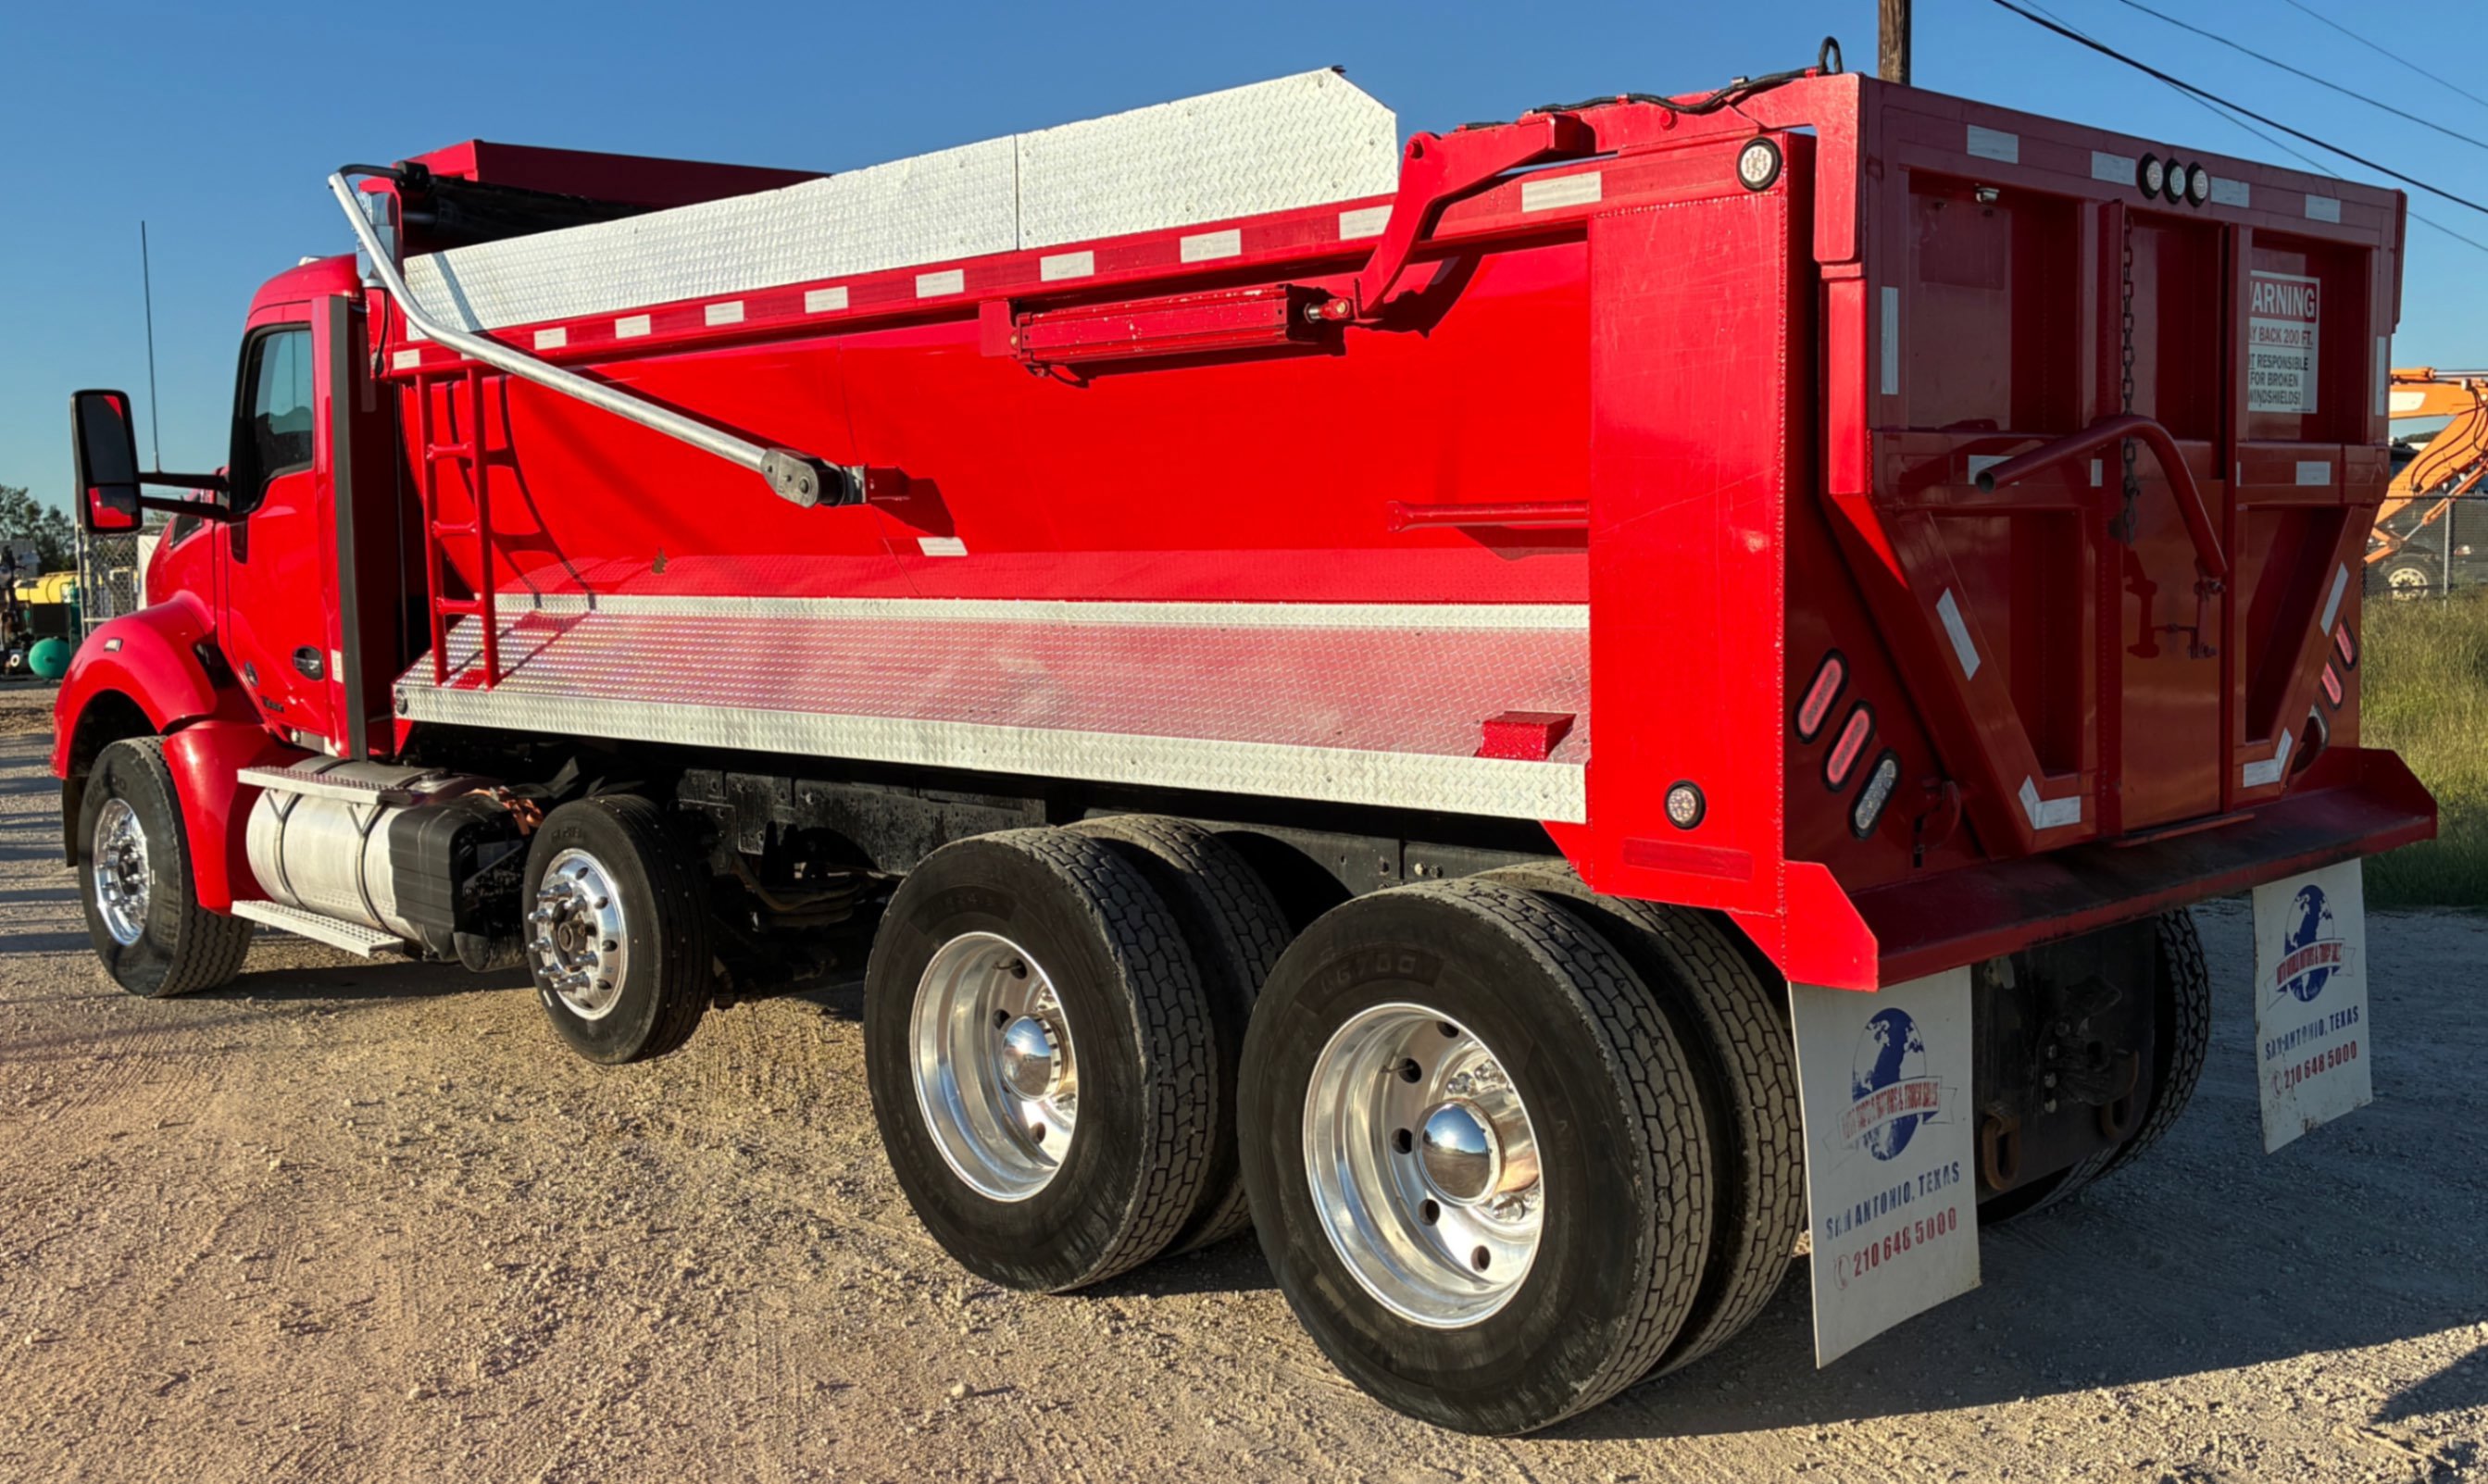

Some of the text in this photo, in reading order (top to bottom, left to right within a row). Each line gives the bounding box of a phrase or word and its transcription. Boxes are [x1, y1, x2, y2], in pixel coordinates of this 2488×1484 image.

[2250, 281, 2315, 318] ARNING
[2259, 328, 2282, 343] BACK
[2283, 329, 2299, 344] 200
[2257, 354, 2308, 370] RESPONSIBLE
[2250, 372, 2298, 387] FOR BROKEN
[2330, 1005, 2359, 1032] TEXAS
[2284, 1041, 2357, 1089] 210 648 5000
[1919, 1161, 1960, 1197] TEXAS
[1854, 1241, 1880, 1278] 210
[1915, 1207, 1957, 1244] 5000
